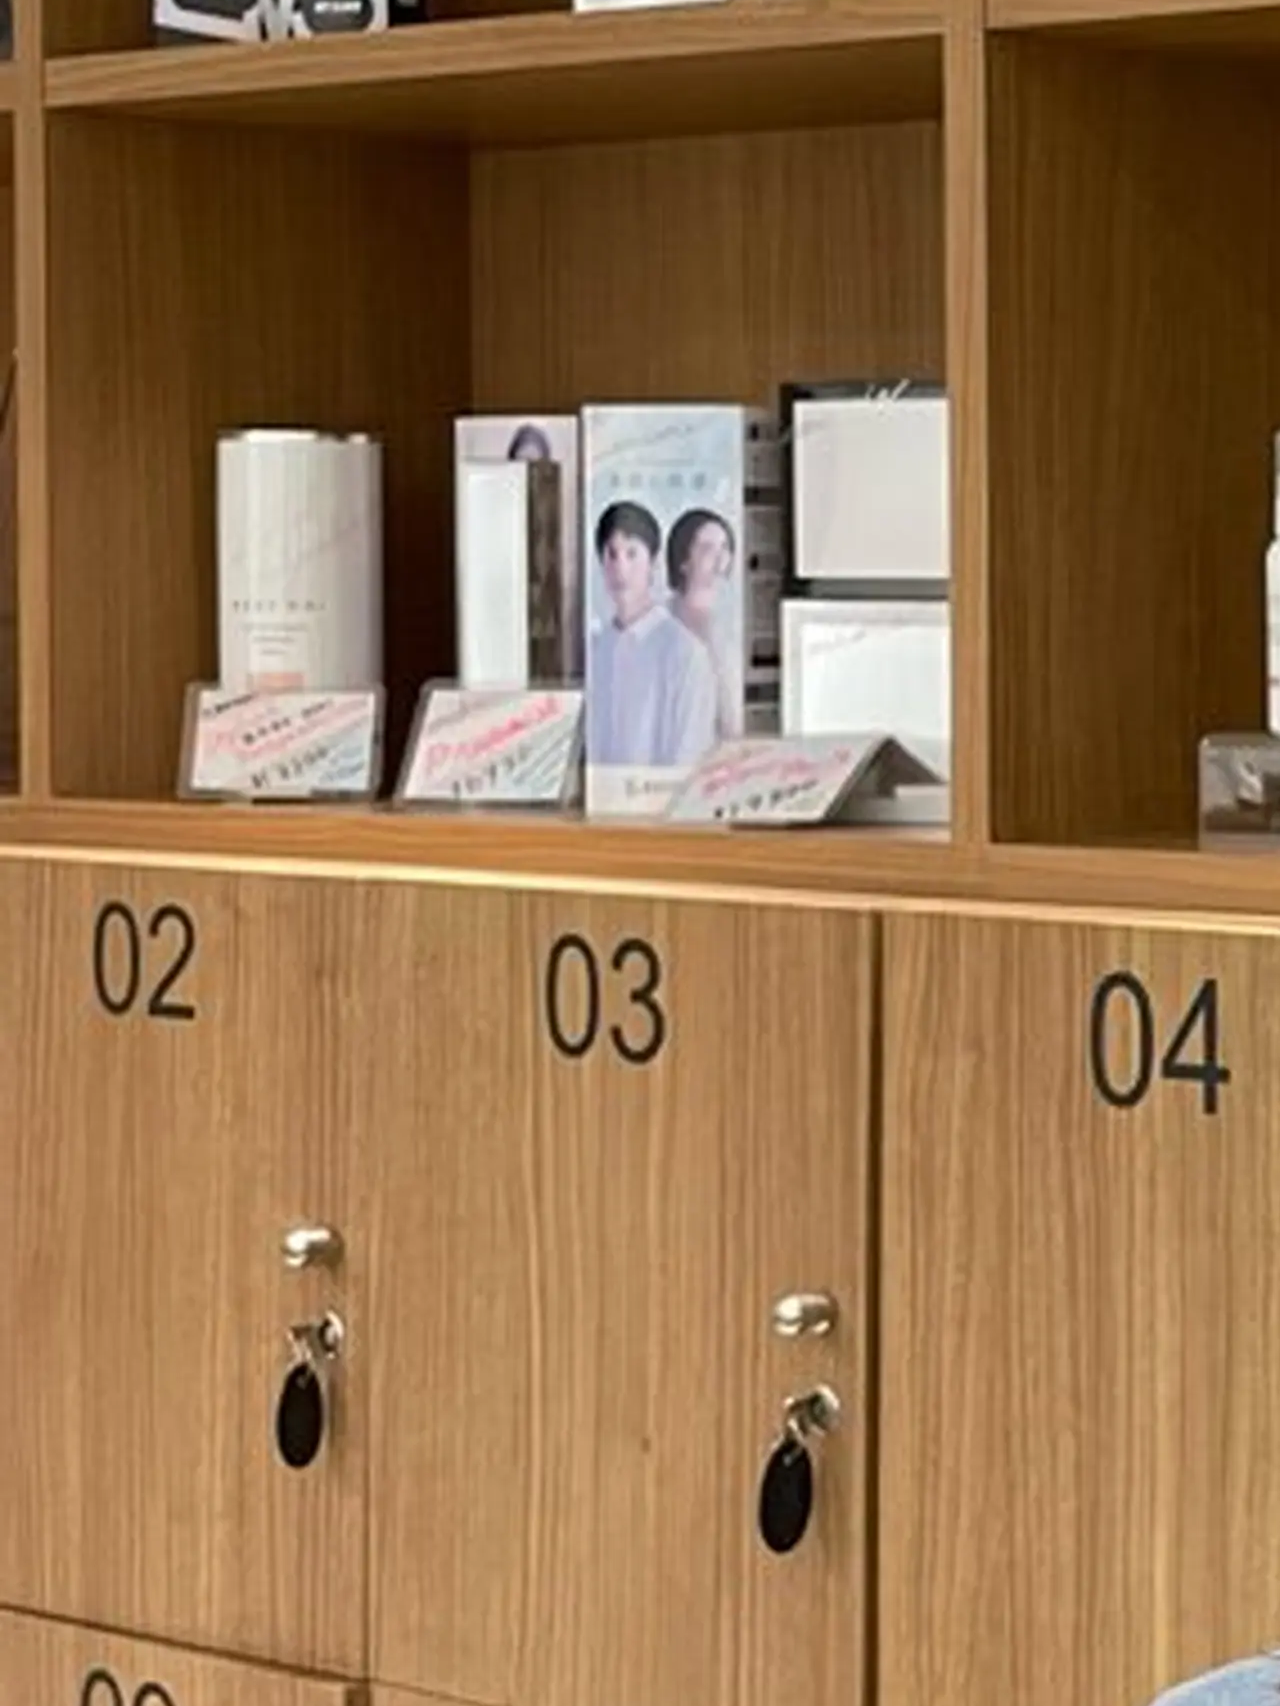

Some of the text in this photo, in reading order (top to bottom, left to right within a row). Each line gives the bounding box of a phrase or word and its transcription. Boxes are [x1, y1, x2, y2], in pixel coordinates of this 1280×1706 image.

[92, 901, 197, 1021] 02
[545, 933, 666, 1065] 03
[1090, 969, 1232, 1115] 04
